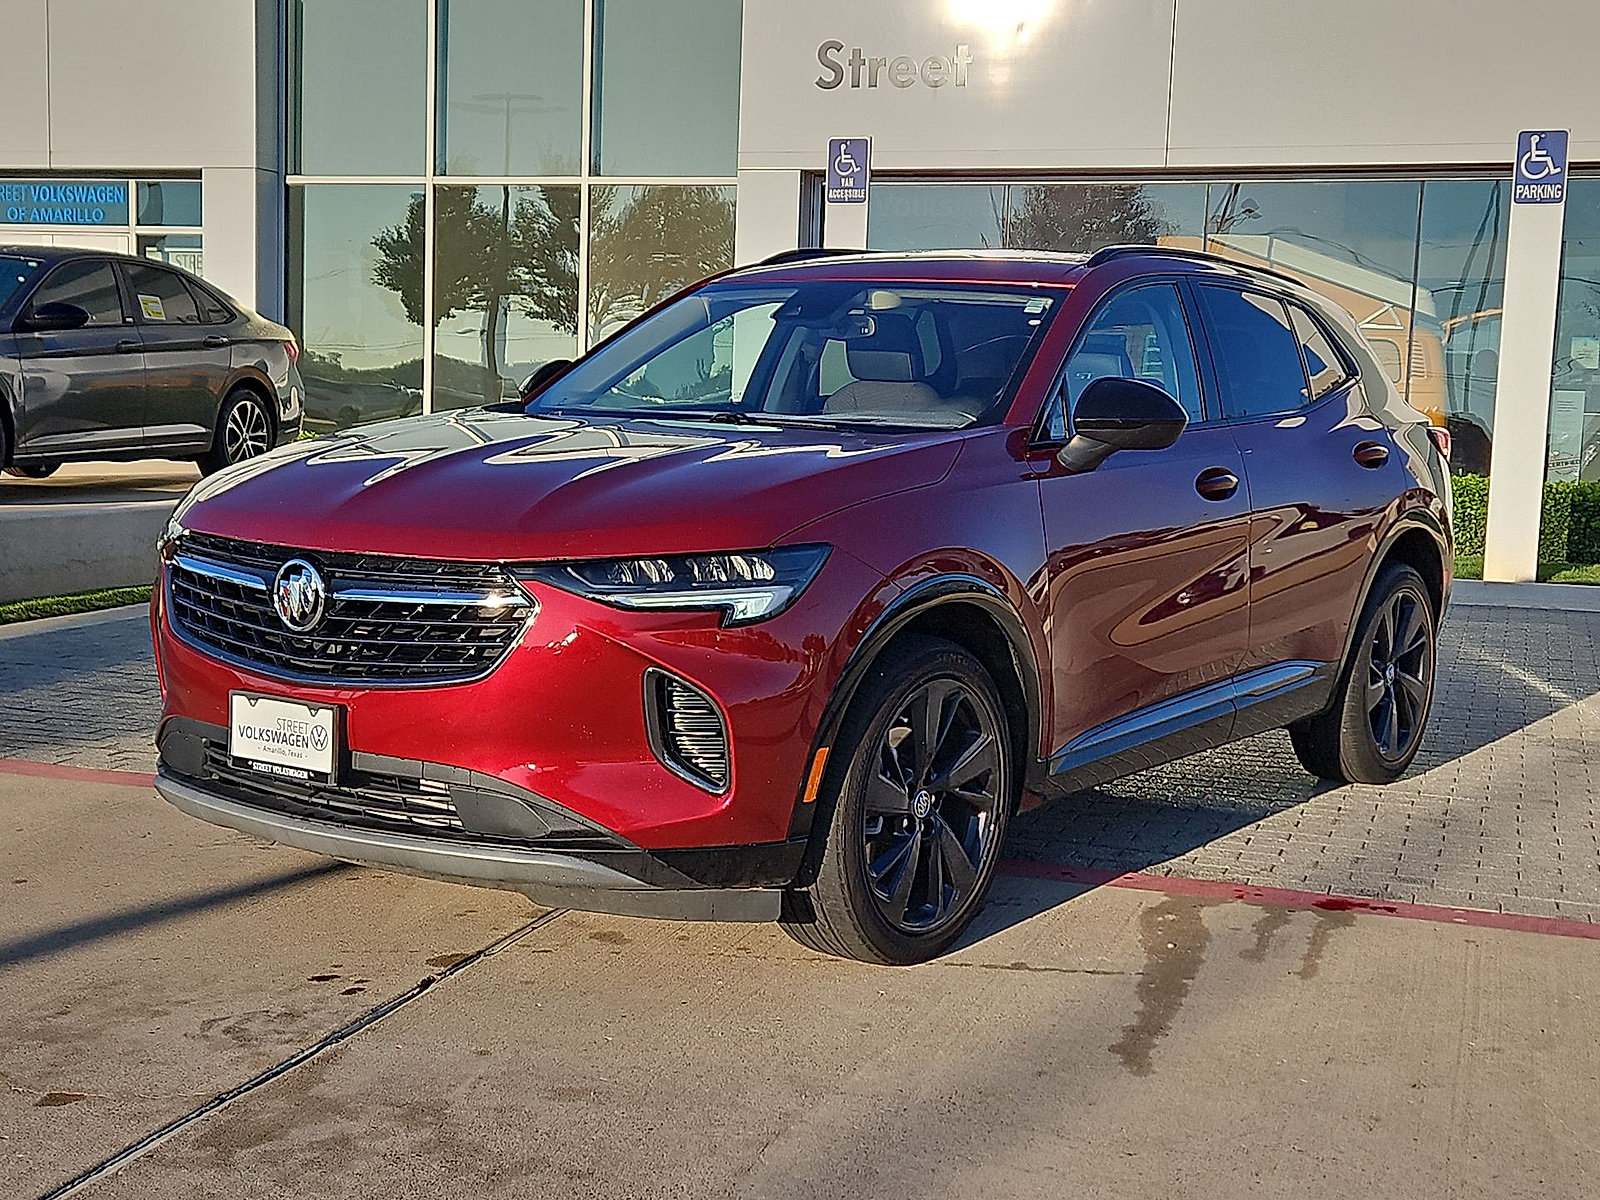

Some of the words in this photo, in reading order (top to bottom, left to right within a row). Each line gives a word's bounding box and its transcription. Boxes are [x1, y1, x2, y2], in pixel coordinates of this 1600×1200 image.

[815, 39, 973, 90] Street
[841, 177, 854, 188] VAN
[29, 184, 126, 203] VOLKSWAGEN
[829, 189, 866, 199] ACCESSIBLE
[1515, 184, 1562, 199] PARKING
[7, 206, 27, 222] OF
[30, 206, 104, 222] AMARILLO
[276, 718, 309, 734] STREET
[238, 724, 309, 750] VOLKSWAGEN
[253, 762, 271, 772] STREET
[273, 765, 308, 779] VOLKSWAGEN
